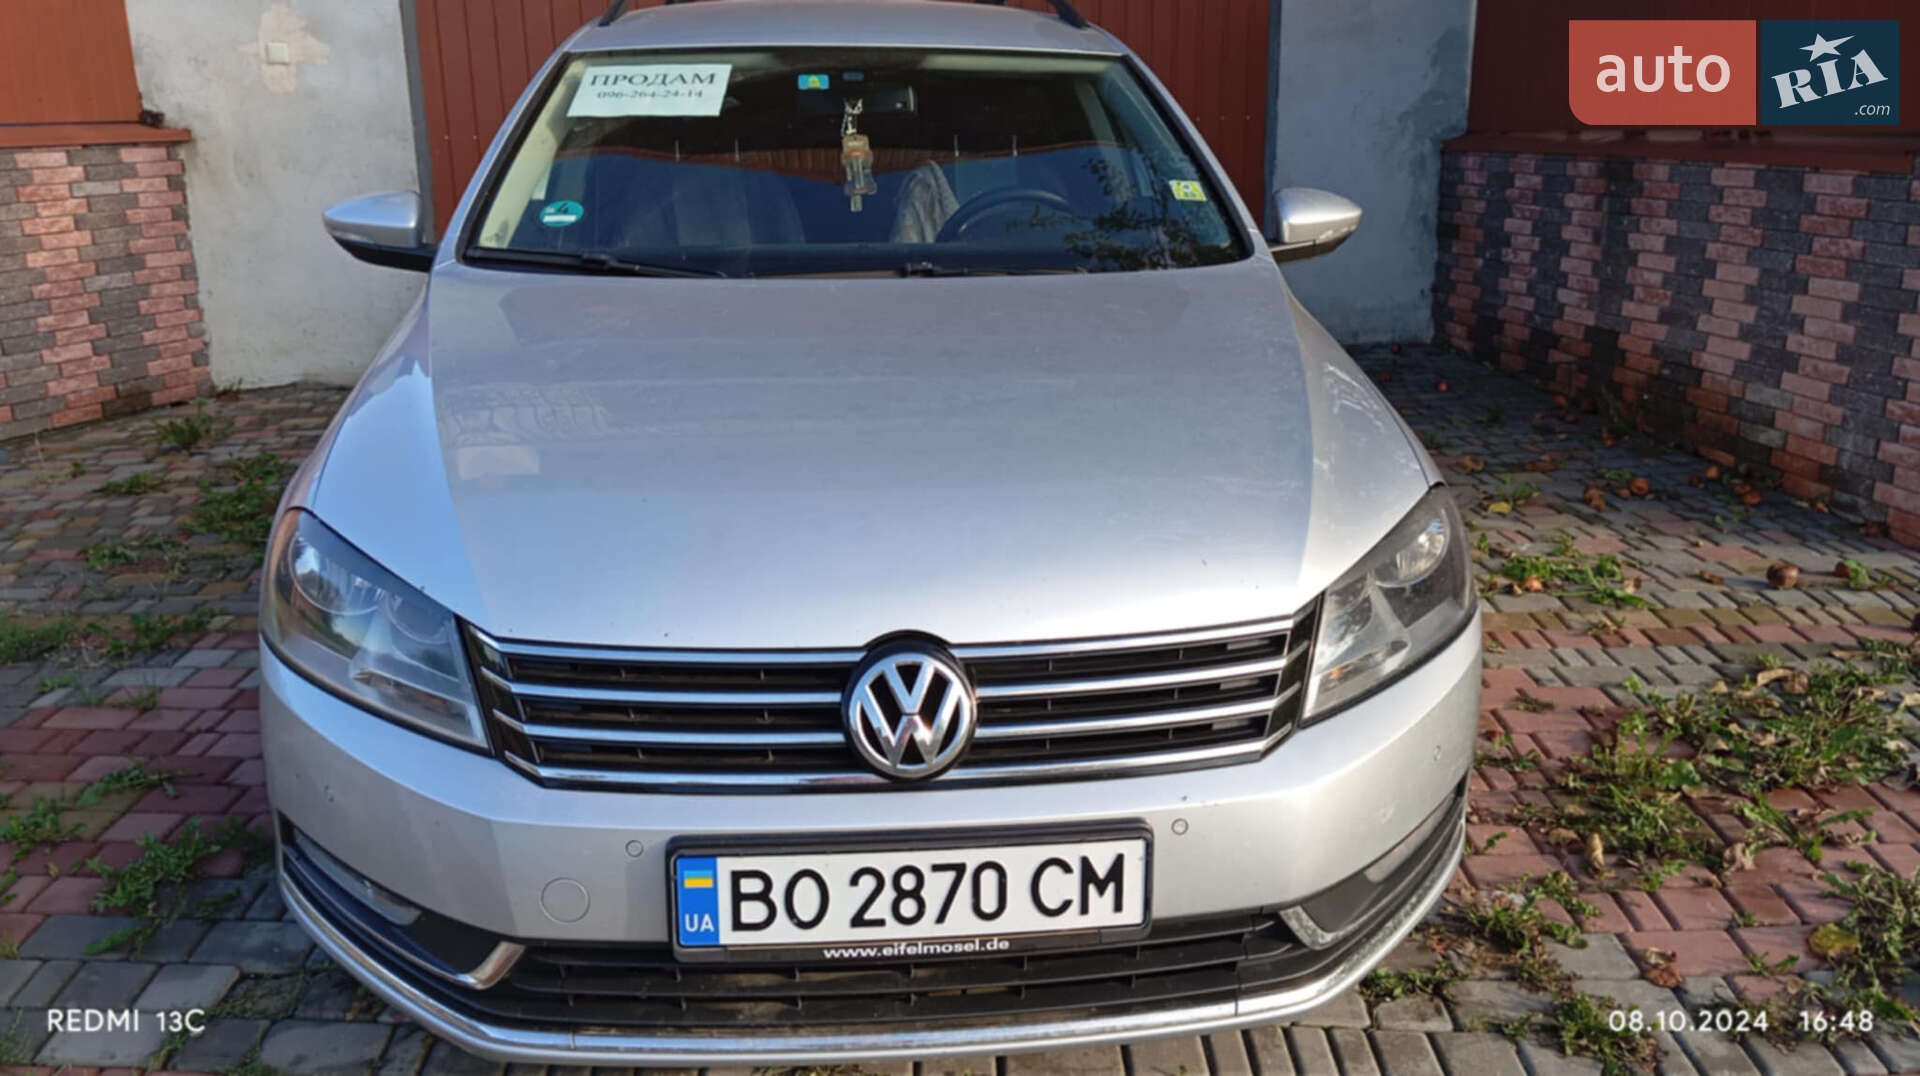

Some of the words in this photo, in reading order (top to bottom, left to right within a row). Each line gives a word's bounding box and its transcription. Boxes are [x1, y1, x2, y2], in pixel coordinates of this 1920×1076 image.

[590, 72, 717, 87] ПРОДАМ
[730, 868, 830, 932] BO
[849, 860, 1007, 928] 2870
[1030, 853, 1125, 918] CM
[684, 914, 715, 933] UA
[823, 939, 1009, 960] www.eifelmosel.de
